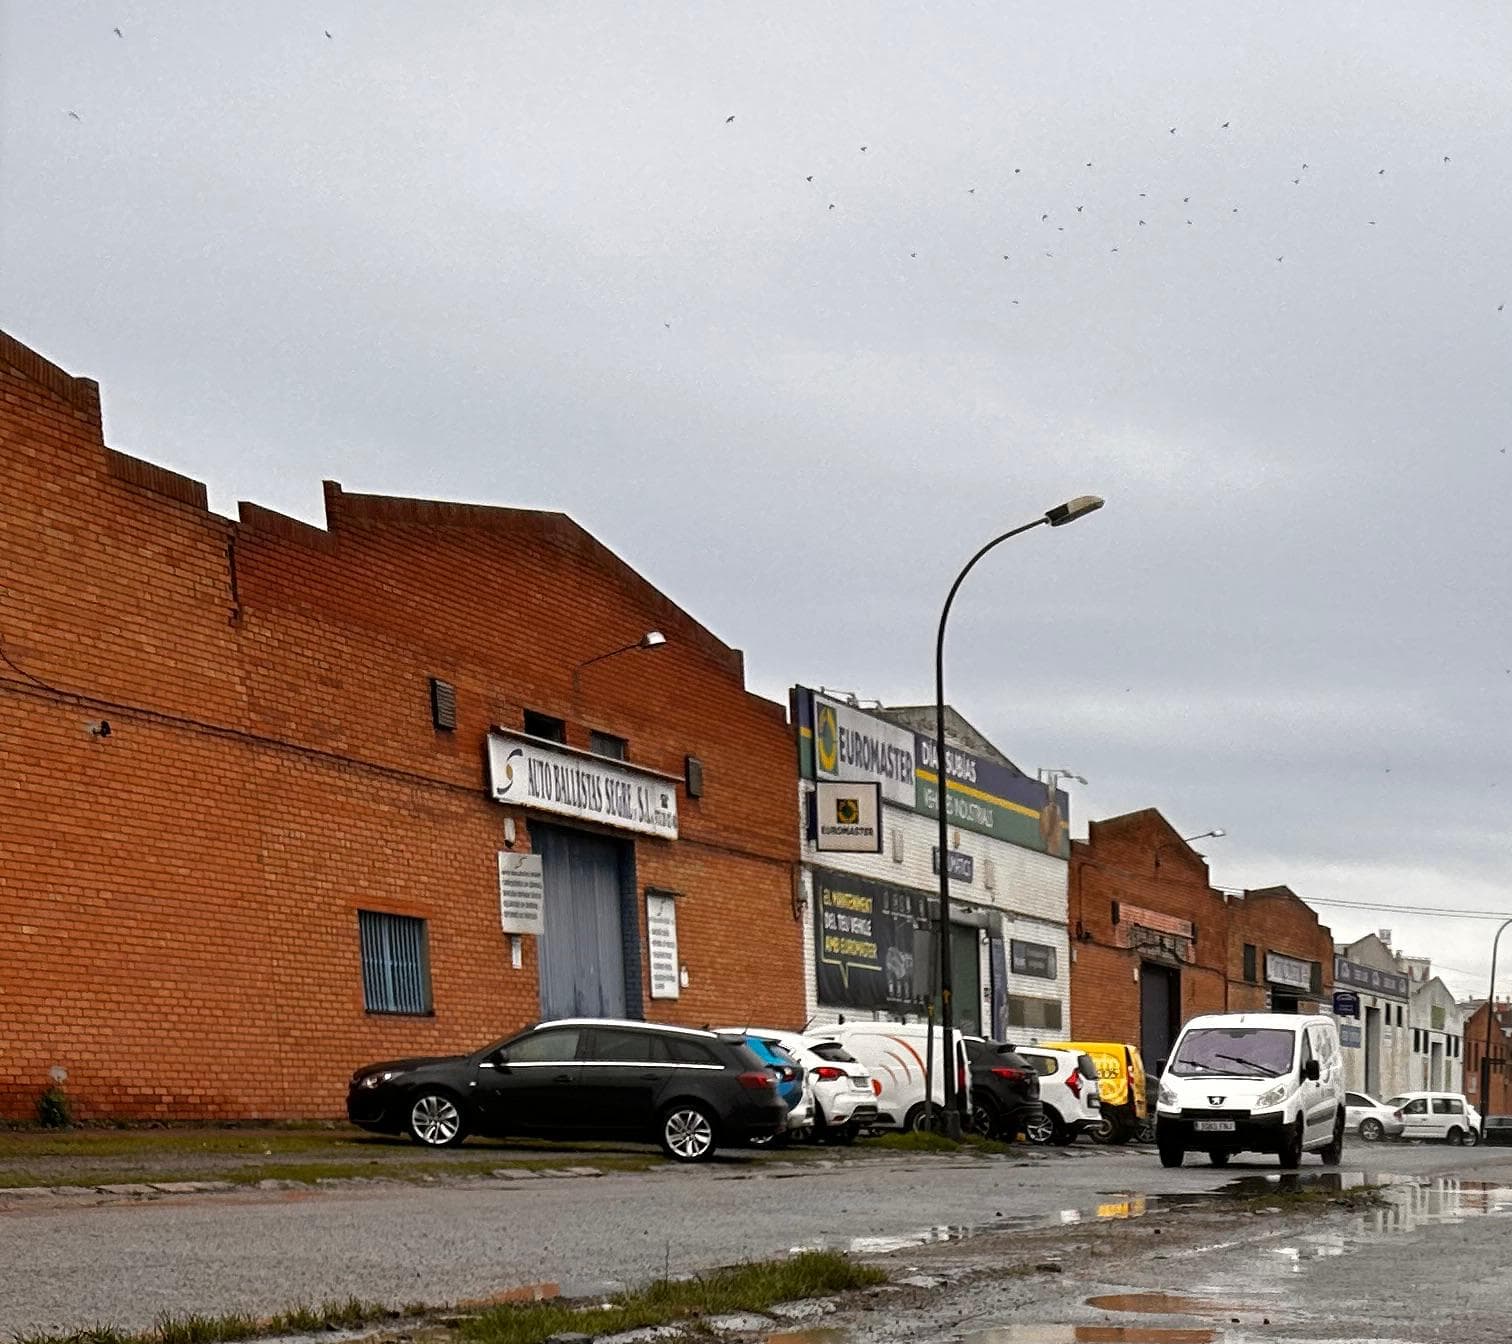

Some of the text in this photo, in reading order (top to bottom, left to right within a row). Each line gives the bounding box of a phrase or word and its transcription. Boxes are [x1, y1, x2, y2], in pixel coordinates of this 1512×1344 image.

[838, 726, 913, 785] EUROMASTER
[527, 757, 551, 801] AUTO
[821, 825, 874, 837] EUROMASTER
